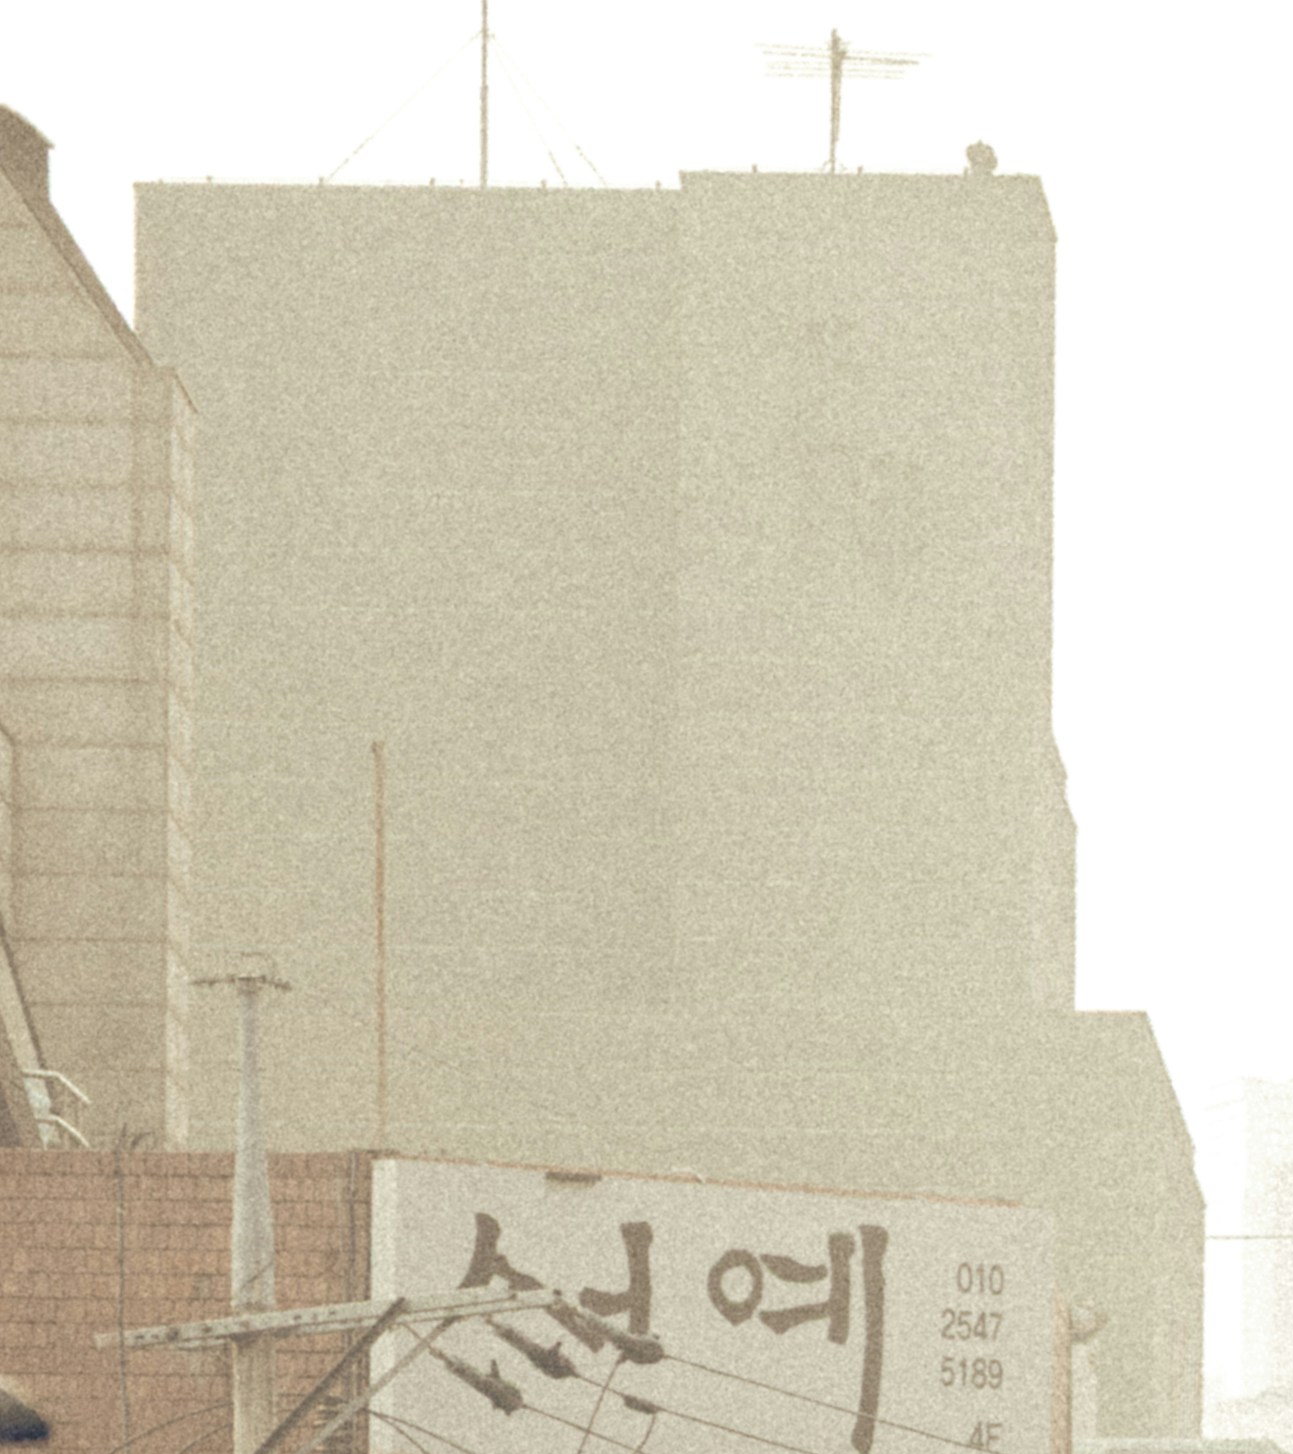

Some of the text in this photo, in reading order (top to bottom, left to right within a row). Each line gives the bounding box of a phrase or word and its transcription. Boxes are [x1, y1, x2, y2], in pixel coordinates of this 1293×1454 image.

[957, 1261, 1003, 1295] 010
[940, 1308, 1003, 1342] 2547
[940, 1356, 1003, 1391] 5189
[970, 1420, 1003, 1454] 4F
